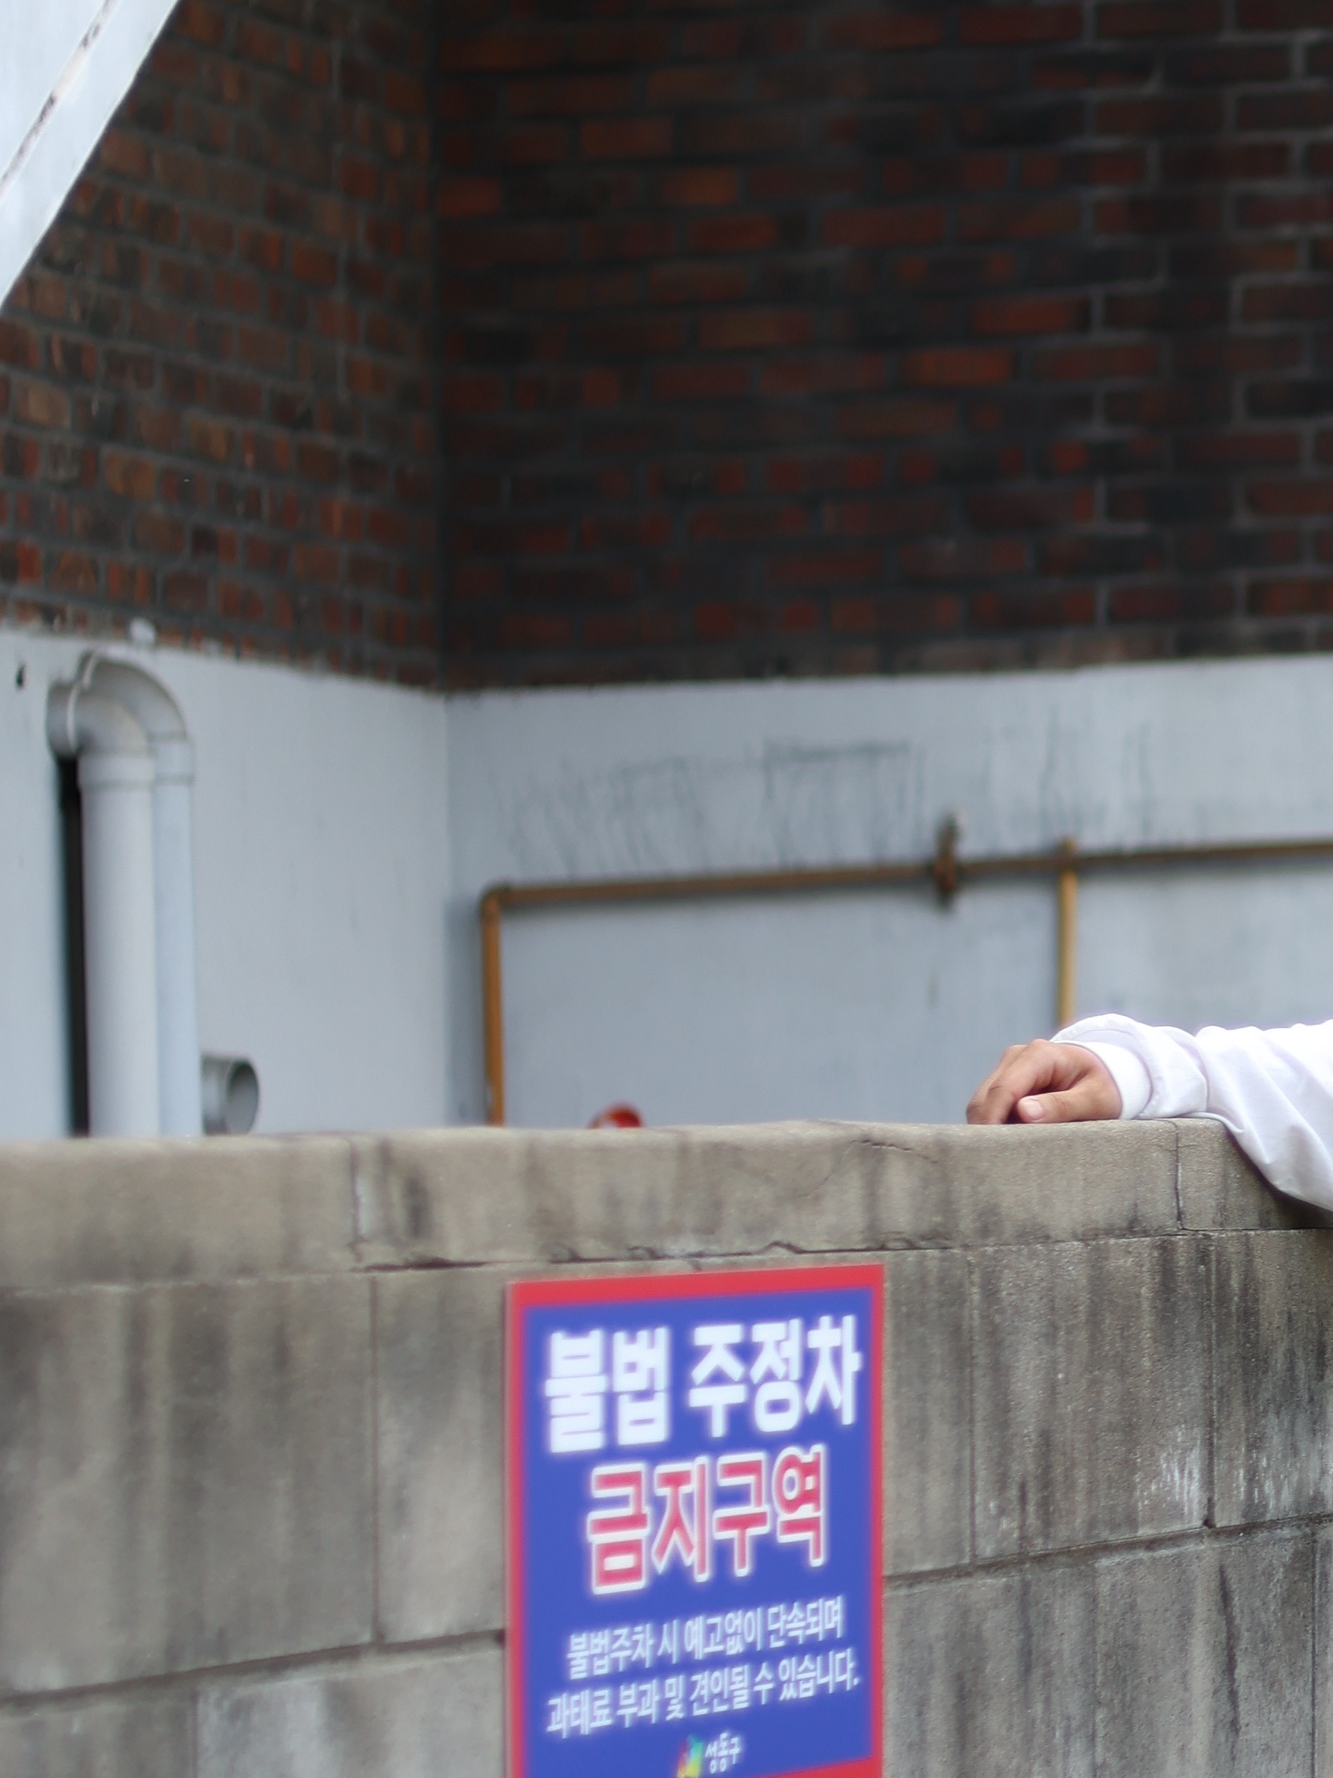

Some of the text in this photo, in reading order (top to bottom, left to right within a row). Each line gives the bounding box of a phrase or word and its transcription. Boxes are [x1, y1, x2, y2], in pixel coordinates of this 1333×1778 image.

[545, 1316, 862, 1453] 불법 주정차
[587, 1444, 827, 1594] 금지구역
[567, 1595, 844, 1680] 불법주차 시 예고없이 단속되며
[547, 1647, 860, 1739] 과태료 부과 및 견인될 수 있습니다.
[705, 1731, 742, 1774] 성동구
